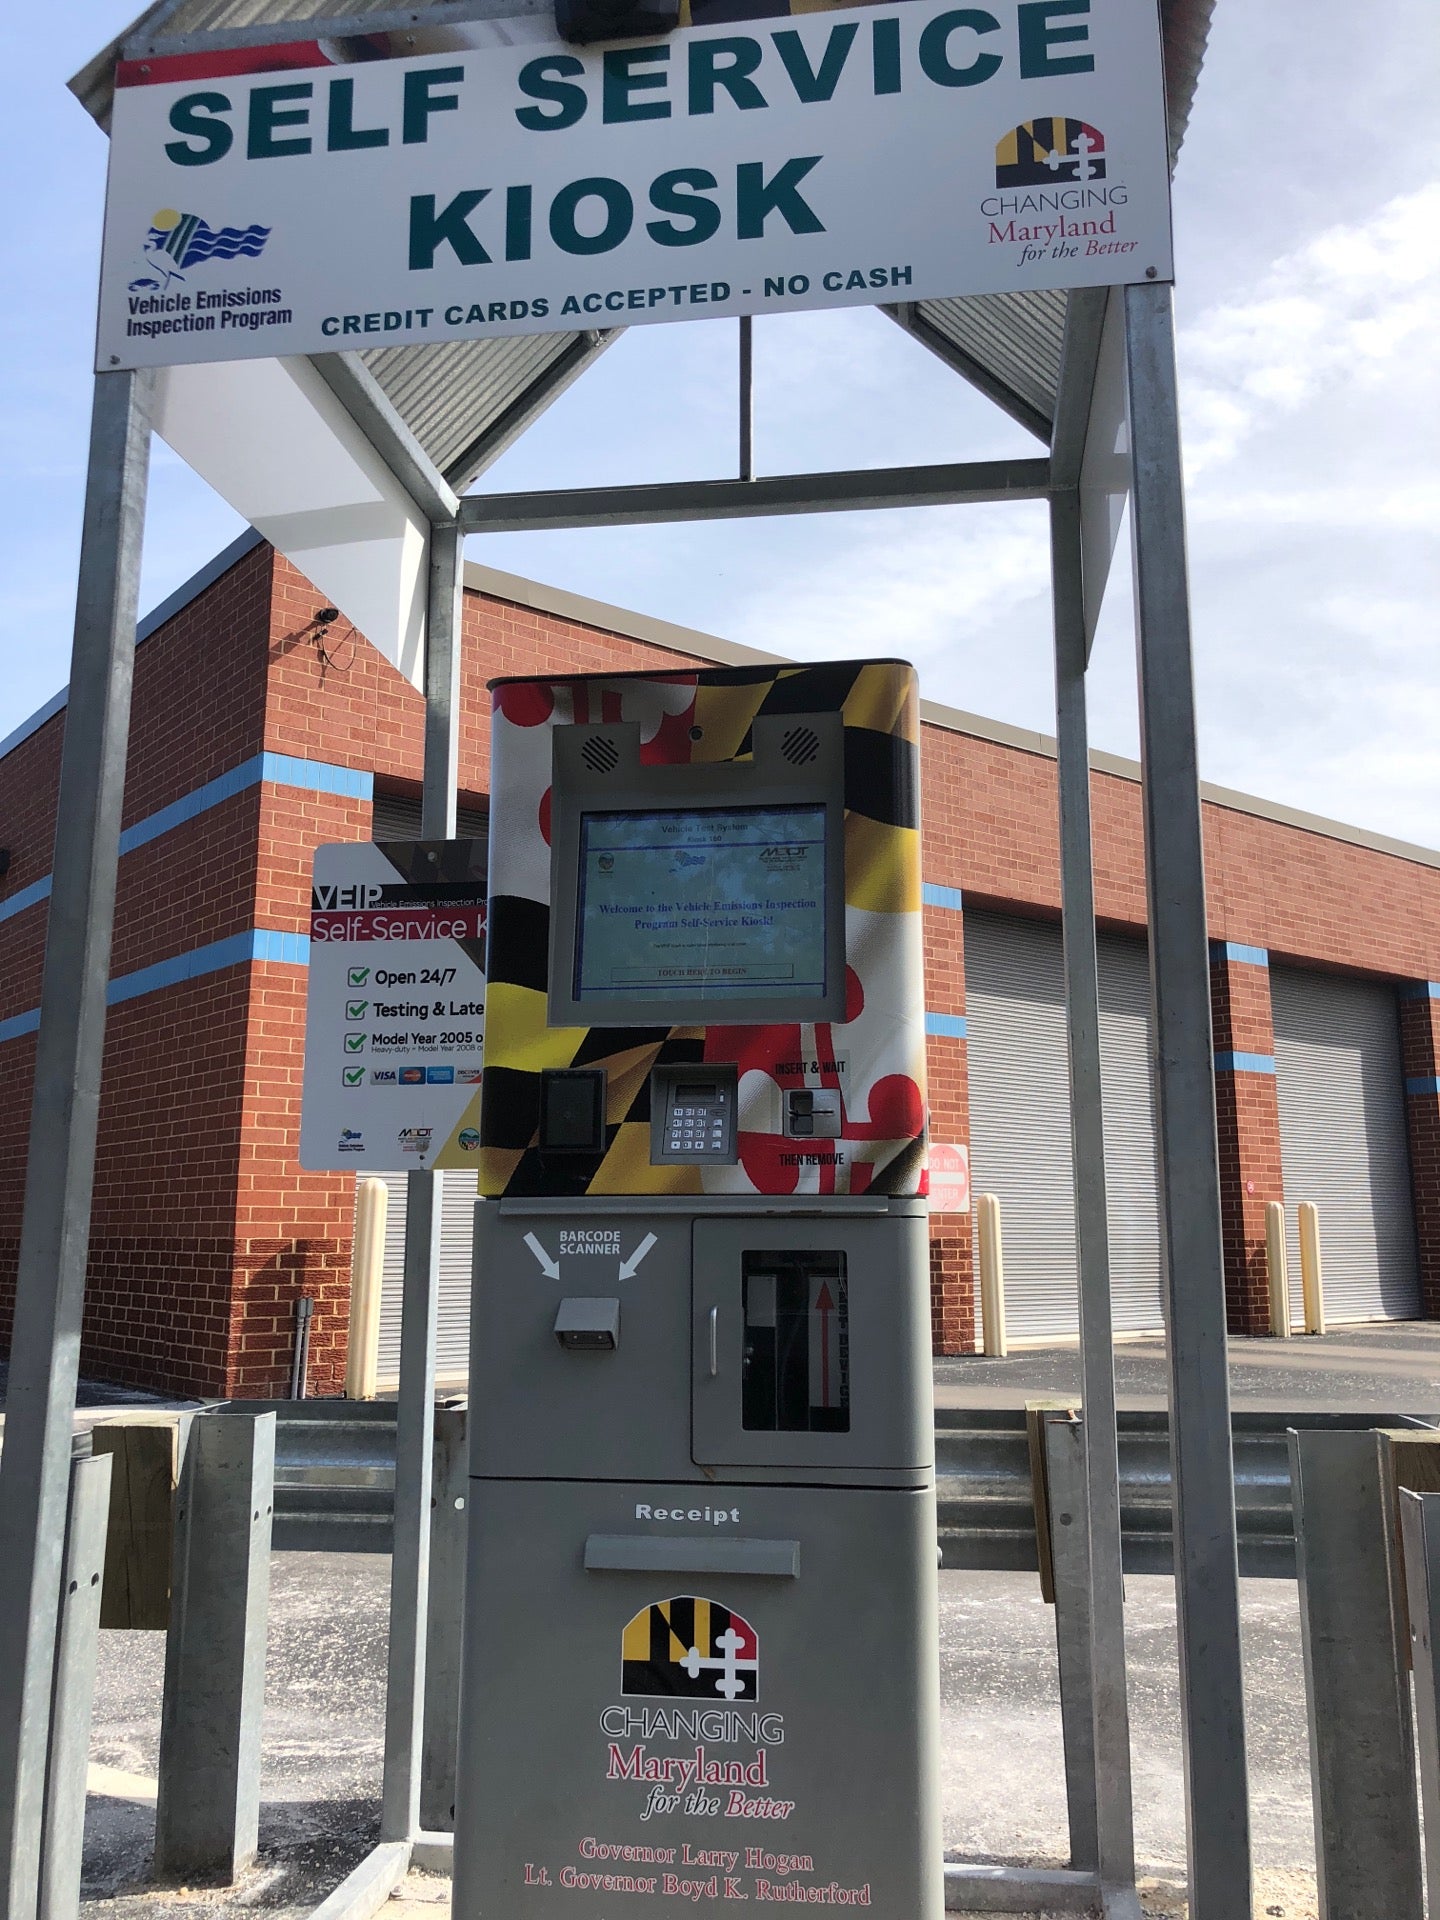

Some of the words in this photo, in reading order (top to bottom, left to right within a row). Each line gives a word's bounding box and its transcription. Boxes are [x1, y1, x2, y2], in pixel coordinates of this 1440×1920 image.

[164, 66, 465, 167] SELF
[515, 0, 1096, 131] SERVICE
[409, 155, 827, 271] KIOSK
[980, 185, 1128, 216] CHANGING
[988, 210, 1117, 246] Maryland
[1016, 244, 1046, 267] for
[1051, 241, 1078, 259] the
[1085, 240, 1138, 256] Better
[128, 293, 191, 315] Vehicle
[196, 288, 282, 310] Emissions
[321, 308, 434, 337] CREDIT
[444, 298, 549, 326] CARDS
[560, 282, 731, 315] ACCEPTED
[764, 275, 810, 297] NO
[822, 265, 912, 291] CASH
[127, 314, 215, 339] Inspection
[220, 308, 293, 331] Program
[312, 884, 383, 910] VEIP
[437, 899, 474, 909] Inspection
[599, 904, 644, 914] Welcome
[646, 904, 655, 913] to
[658, 903, 673, 912] the
[675, 902, 710, 912] Vehicle
[713, 901, 763, 911] Emissions
[766, 899, 817, 911] Inspection
[312, 914, 467, 942] Self-Service
[635, 919, 678, 930] Program
[680, 918, 738, 928] Self-Service
[375, 969, 416, 988] Open
[420, 968, 457, 987] 24/7
[373, 1002, 428, 1020] Testing
[432, 1001, 445, 1016] &
[372, 1033, 408, 1045] Model
[411, 1032, 437, 1044] Year
[440, 1031, 473, 1044] 2005
[374, 1071, 396, 1080] VISA
[775, 1062, 808, 1075] INSERT
[810, 1061, 820, 1073] &
[822, 1061, 846, 1073] WAIT
[779, 1153, 803, 1166] THEN
[806, 1153, 844, 1166] REMOVE
[943, 1158, 960, 1169] NOT
[560, 1230, 620, 1242] BARCODE
[560, 1243, 620, 1255] SCANNER
[635, 1504, 740, 1526] Receipt
[600, 1706, 785, 1744] CHANGING
[606, 1743, 769, 1792] Maryland
[641, 1785, 679, 1821] for
[684, 1788, 720, 1816] the
[724, 1790, 794, 1820] Better
[578, 1836, 676, 1864] Governor
[682, 1843, 739, 1872] Larry
[745, 1847, 814, 1875] Hogan
[524, 1863, 553, 1886] Lt.
[559, 1866, 657, 1894] Governor
[663, 1873, 718, 1901] Boyd
[723, 1876, 749, 1900] K.
[756, 1879, 871, 1906] Rutherford
